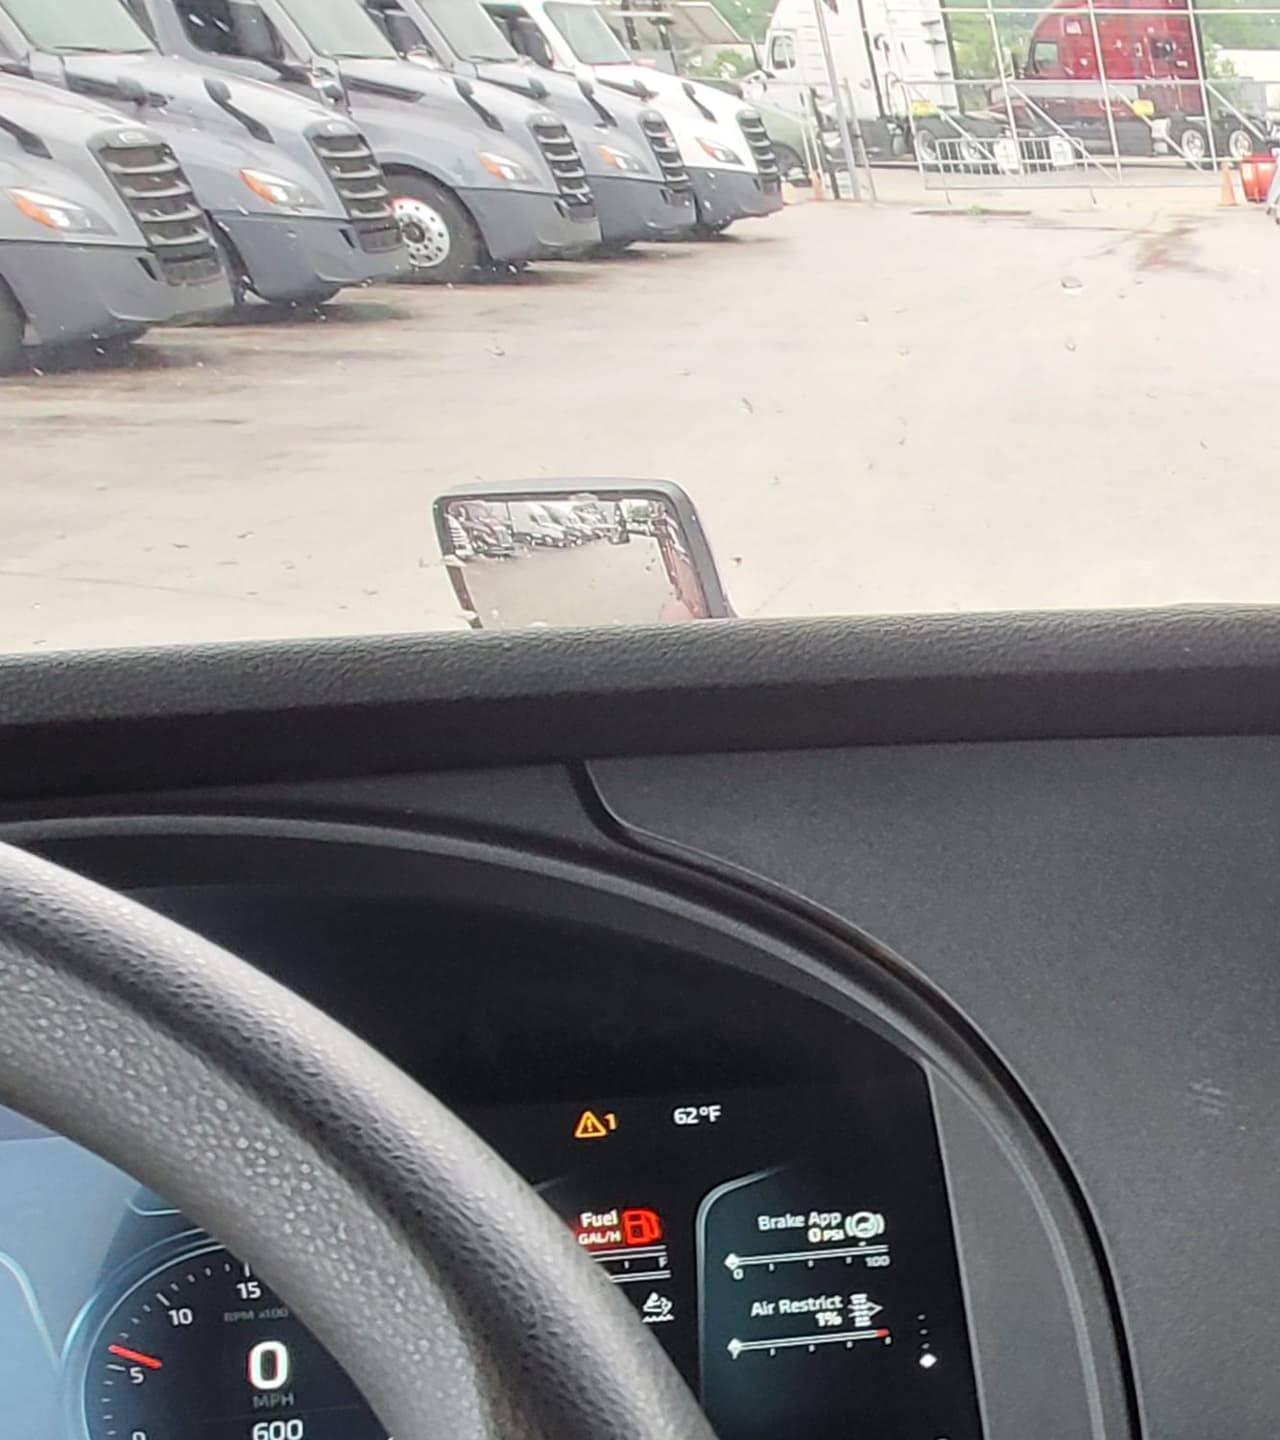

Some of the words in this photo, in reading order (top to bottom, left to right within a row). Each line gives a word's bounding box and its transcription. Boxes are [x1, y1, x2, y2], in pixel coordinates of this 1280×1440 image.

[673, 1105, 722, 1124] 62°F
[580, 1209, 618, 1228] Fuel
[757, 1214, 806, 1231] Brake
[807, 1211, 842, 1231] App
[864, 1256, 891, 1267] 100
[236, 1281, 261, 1299] 15
[750, 1300, 776, 1317] Air
[778, 1295, 843, 1314] Restrict
[168, 1308, 193, 1326] 10
[814, 1312, 843, 1327] 1%
[248, 1340, 288, 1390] 0
[130, 1367, 145, 1384] 5
[252, 1392, 295, 1408] MPH
